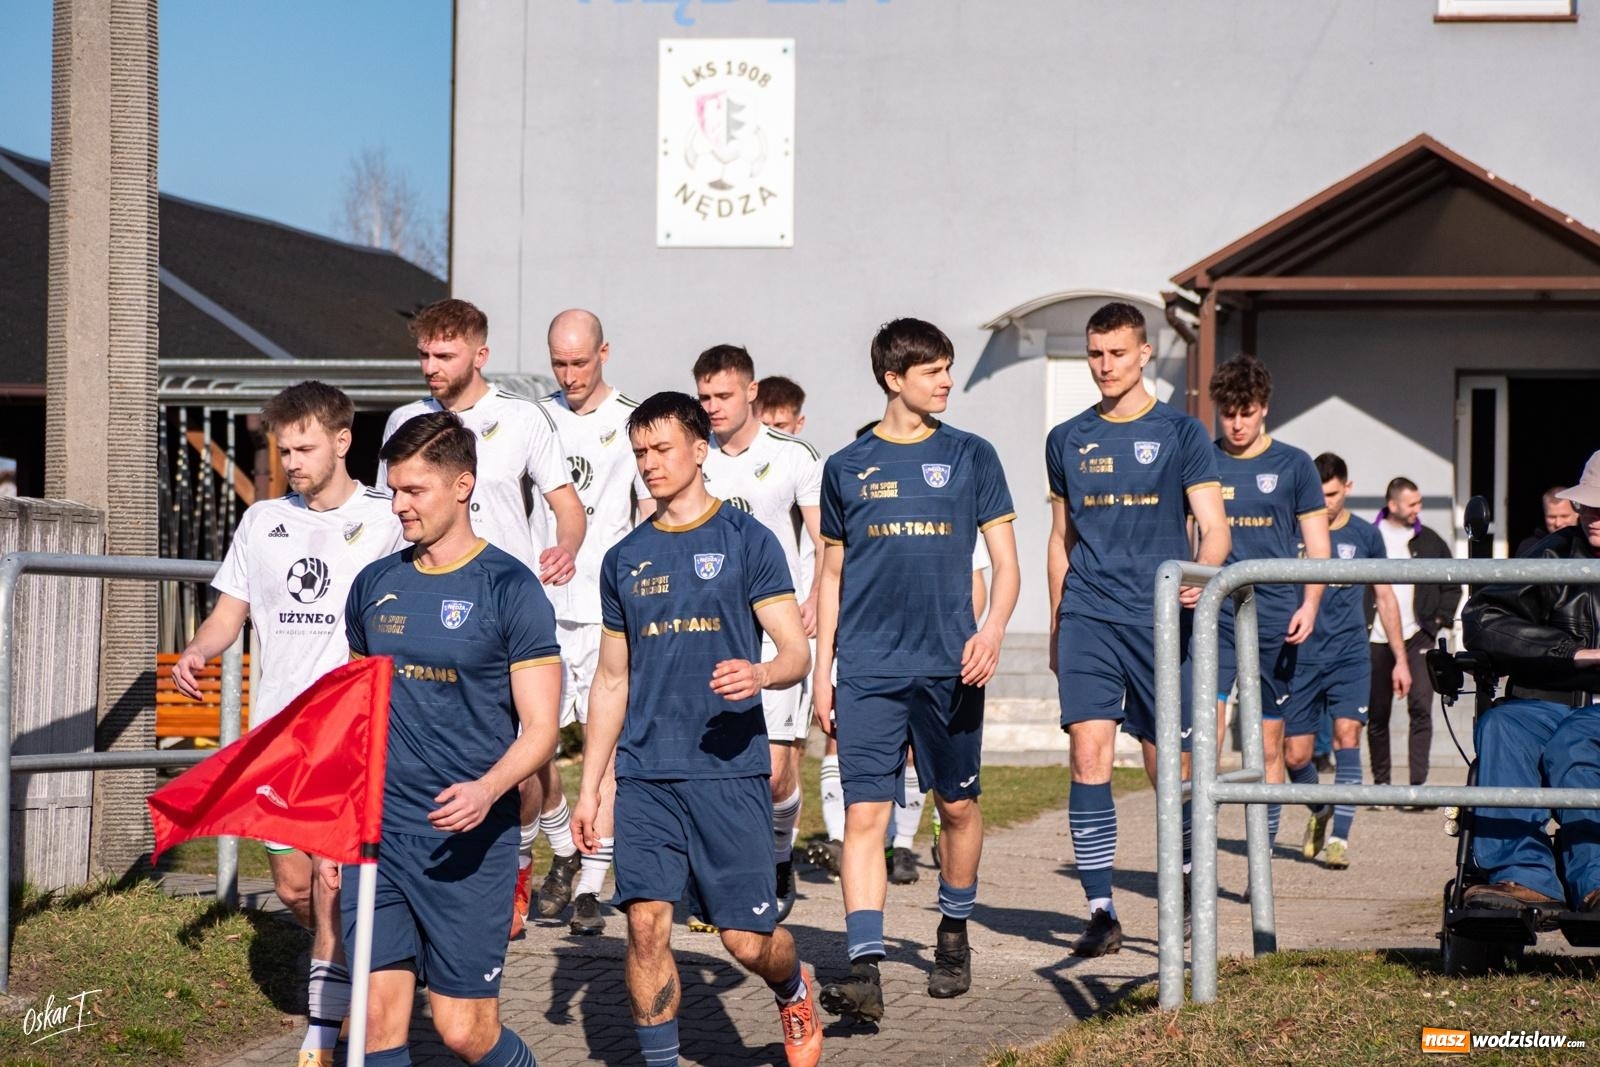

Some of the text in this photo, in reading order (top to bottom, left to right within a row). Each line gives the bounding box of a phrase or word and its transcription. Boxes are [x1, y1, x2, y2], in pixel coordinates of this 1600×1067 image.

[681, 60, 772, 88] LKS 1908
[674, 182, 778, 220] NĘDZA
[1083, 494, 1159, 506] MAN-RANS
[867, 521, 953, 537] MAN-TRANS
[393, 664, 458, 683] -TRANS
